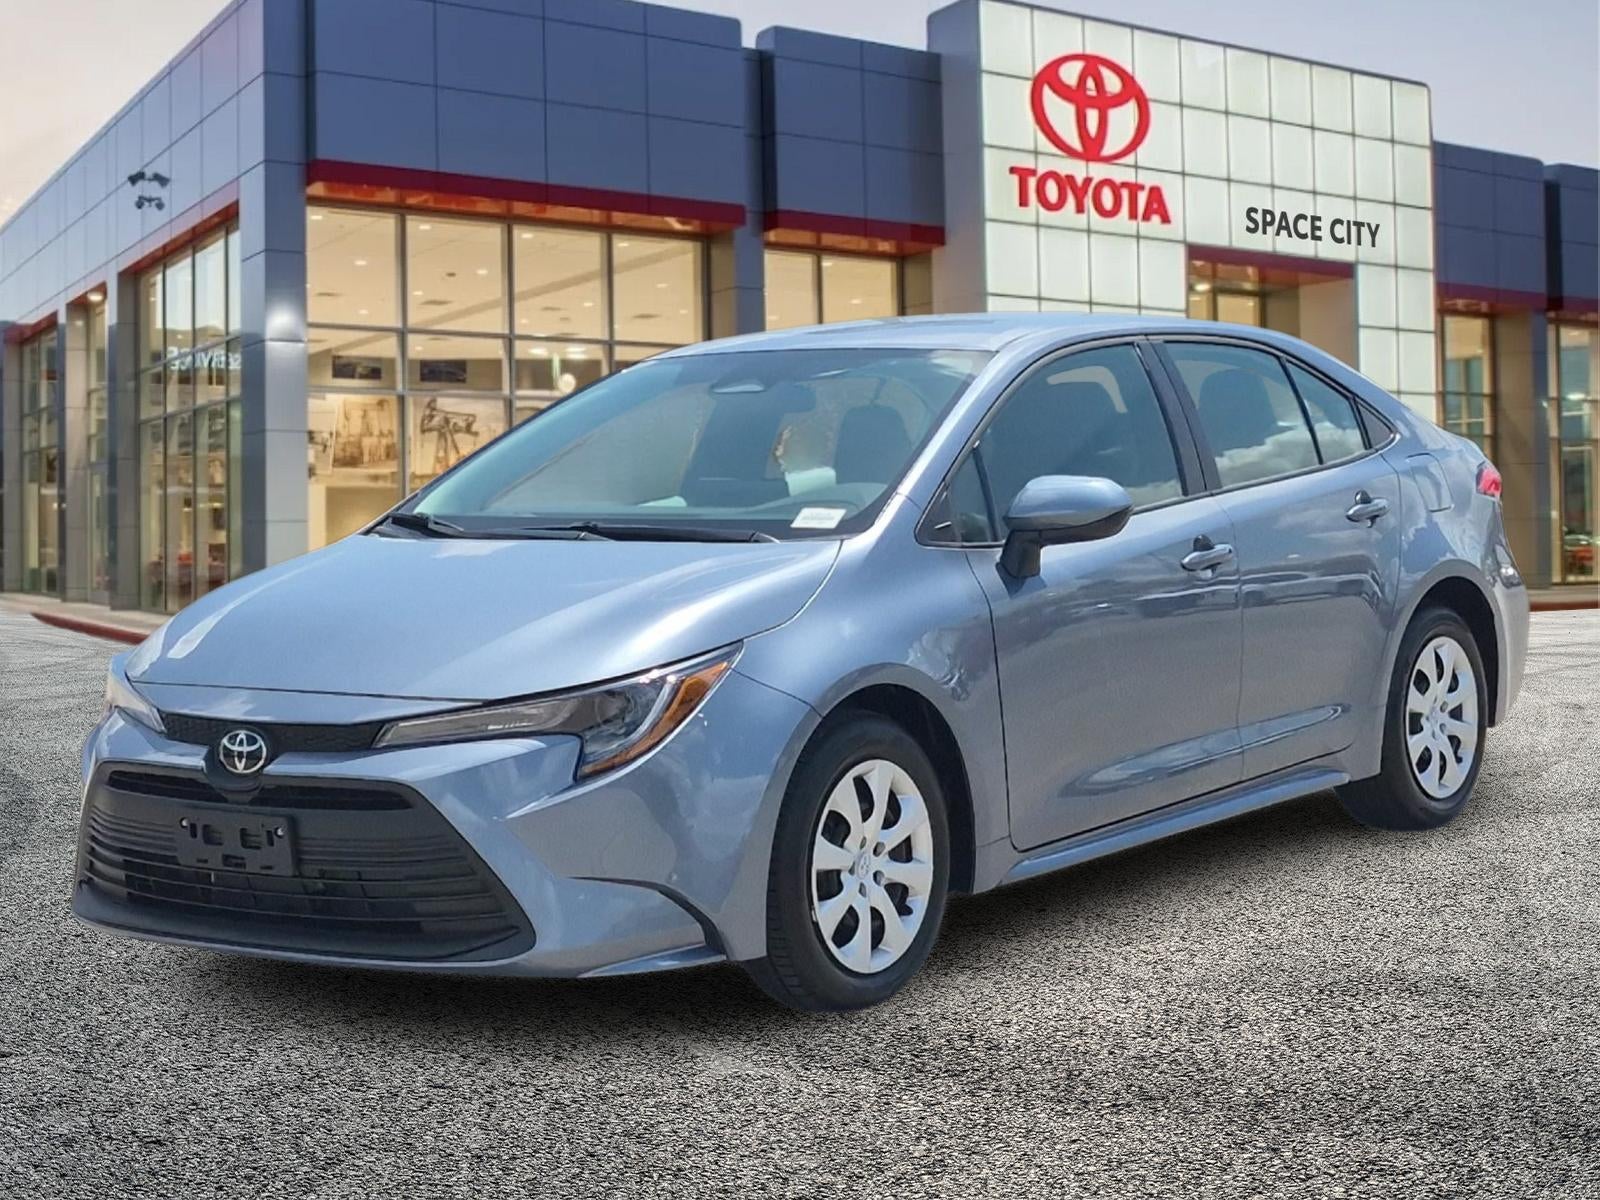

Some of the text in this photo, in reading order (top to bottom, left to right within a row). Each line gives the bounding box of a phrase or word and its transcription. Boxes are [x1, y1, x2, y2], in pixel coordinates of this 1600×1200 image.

[1009, 166, 1171, 224] TOYOTA
[1245, 206, 1380, 248] SPACE CITY
